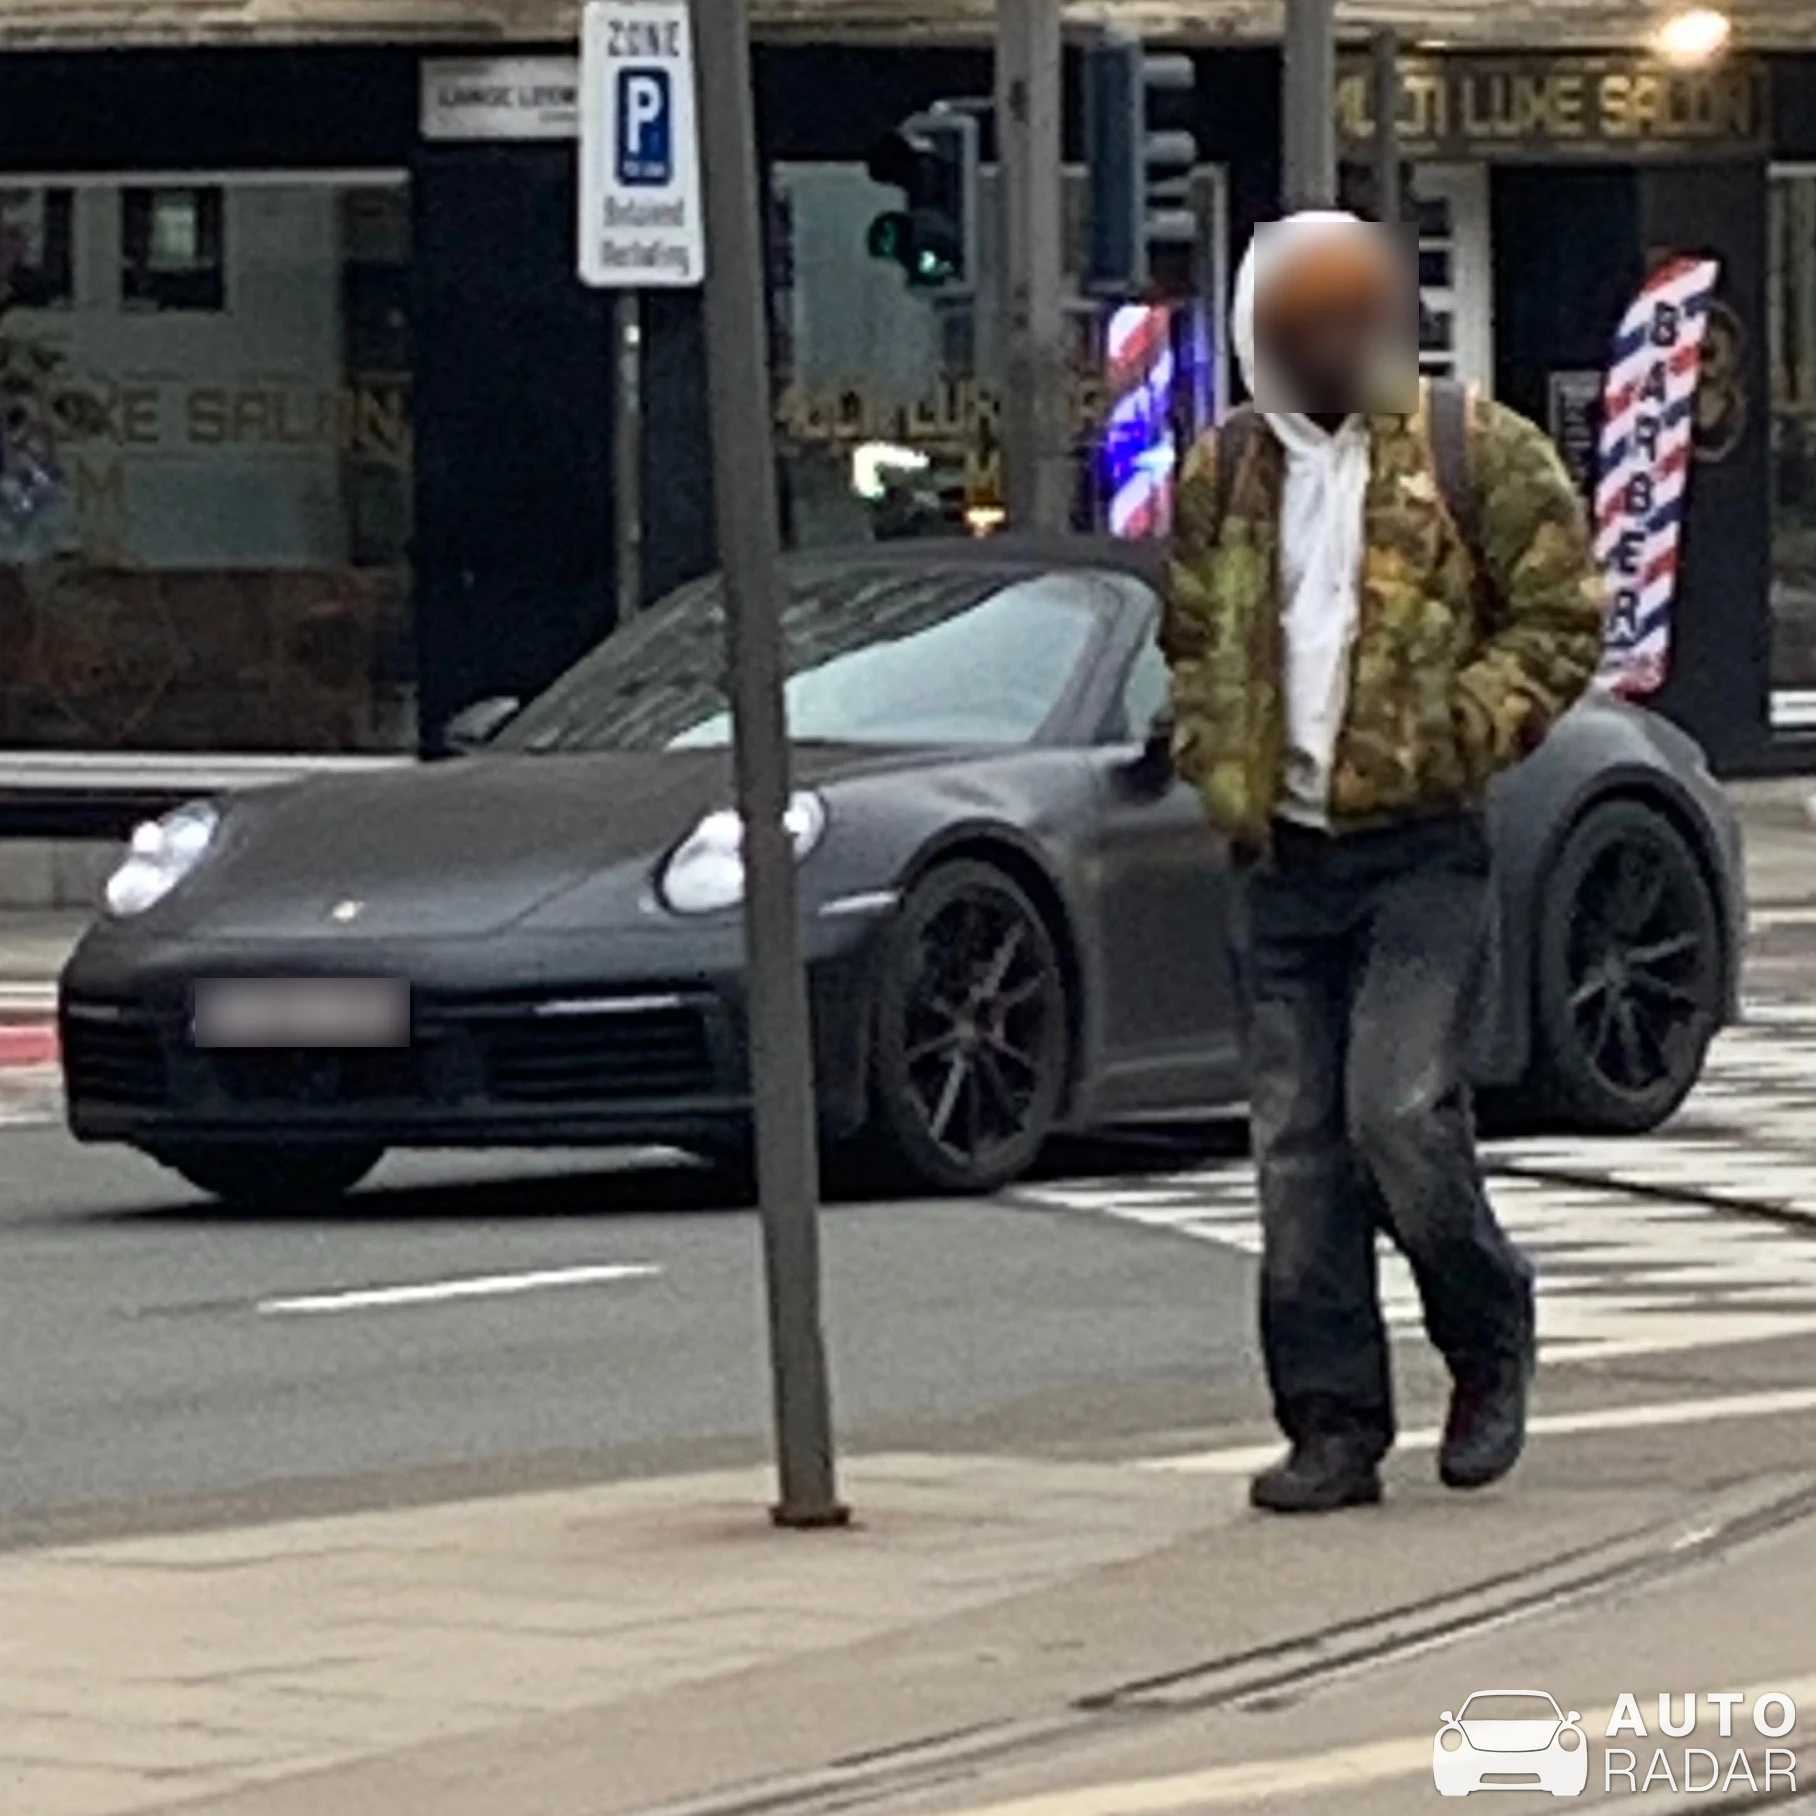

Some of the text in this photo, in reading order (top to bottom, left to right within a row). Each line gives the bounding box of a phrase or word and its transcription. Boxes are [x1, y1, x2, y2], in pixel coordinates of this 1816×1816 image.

[607, 20, 680, 57] ZONE
[627, 76, 662, 153] P
[1608, 300, 1680, 632] BARBER
